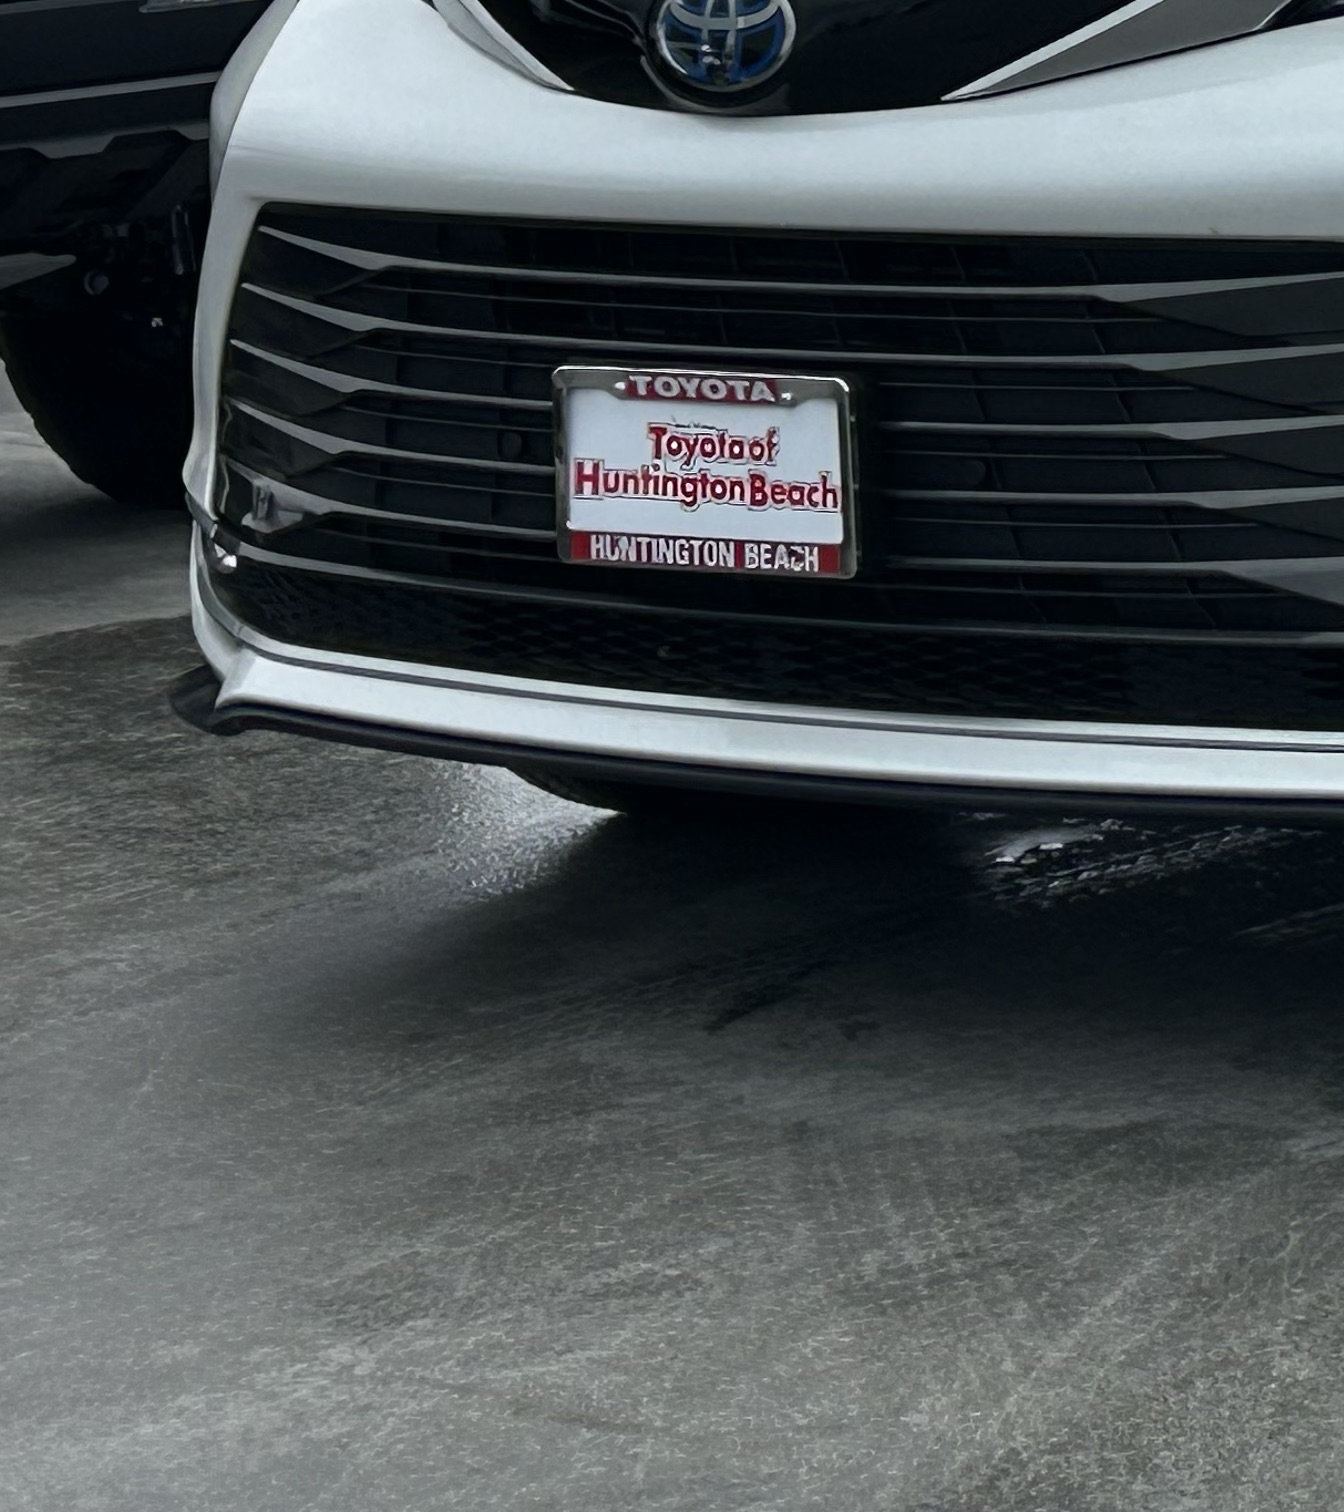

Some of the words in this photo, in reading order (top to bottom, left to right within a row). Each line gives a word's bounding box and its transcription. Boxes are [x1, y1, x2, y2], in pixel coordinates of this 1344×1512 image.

[629, 374, 776, 402] TOYOTA
[648, 423, 744, 468] Toyota
[748, 426, 780, 465] of
[574, 459, 745, 510] Huntington
[748, 469, 839, 511] Beach
[589, 534, 735, 568] HUNTINGTON
[744, 543, 820, 572] BEACH
